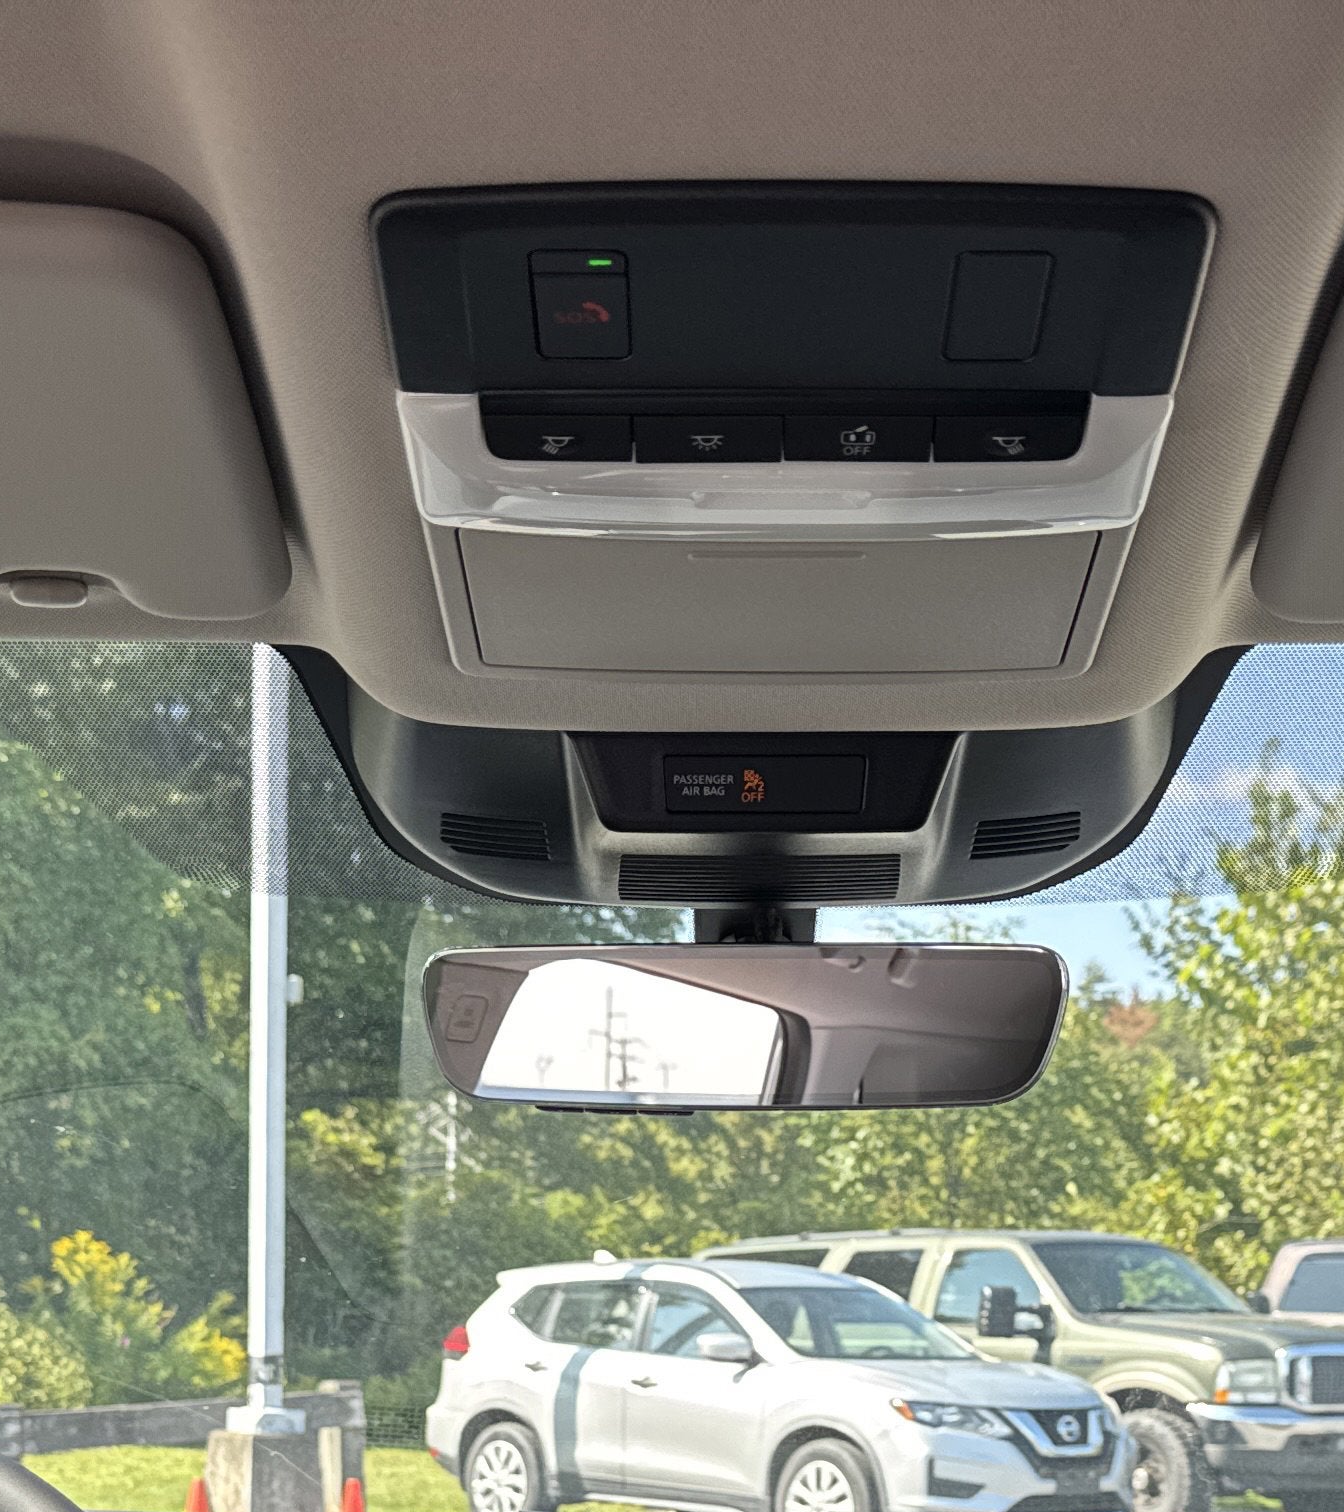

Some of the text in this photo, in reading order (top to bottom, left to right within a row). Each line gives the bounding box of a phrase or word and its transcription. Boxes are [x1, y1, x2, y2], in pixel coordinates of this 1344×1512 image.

[843, 446, 871, 456] OFF
[673, 774, 735, 785] PASSENGER
[681, 786, 726, 796] AIR BAG
[741, 792, 765, 803] OFF
